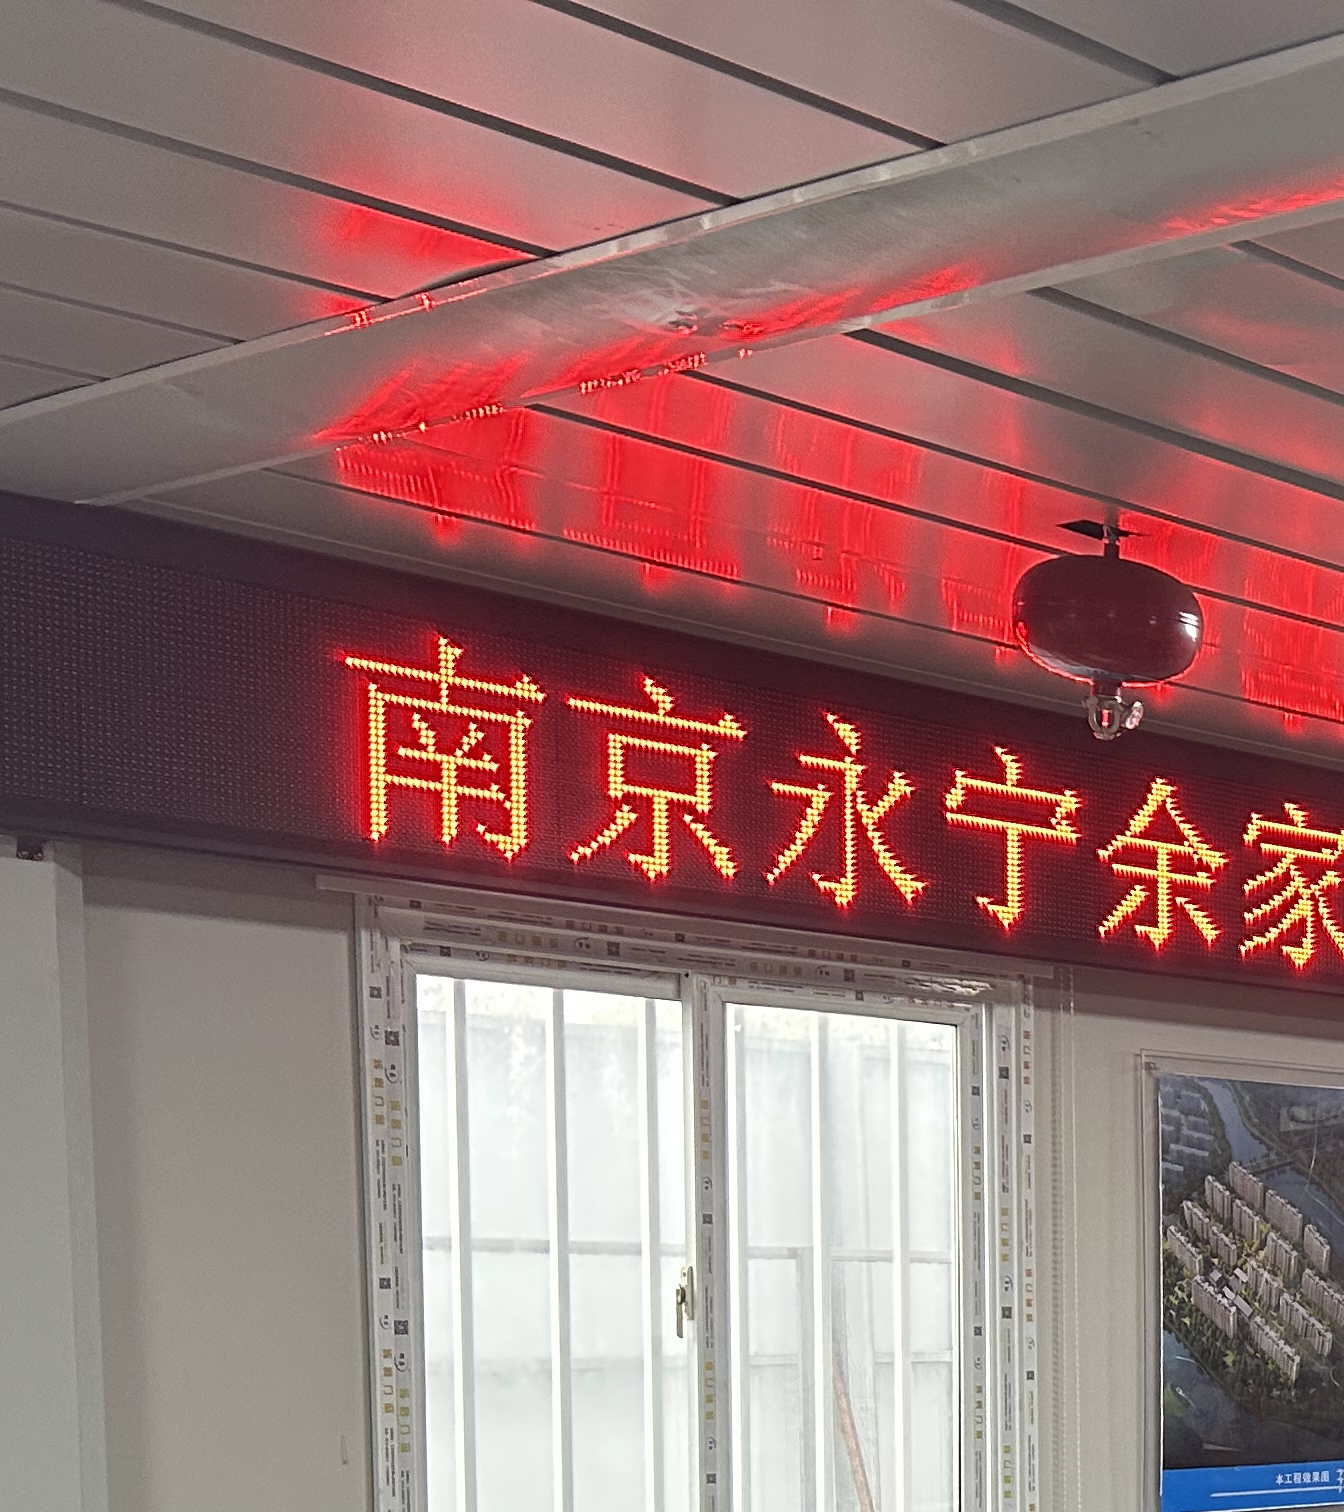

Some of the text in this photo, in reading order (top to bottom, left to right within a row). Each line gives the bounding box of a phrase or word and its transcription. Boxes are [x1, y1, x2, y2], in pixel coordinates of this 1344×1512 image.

[1275, 1470, 1330, 1486] 本工程效果图
